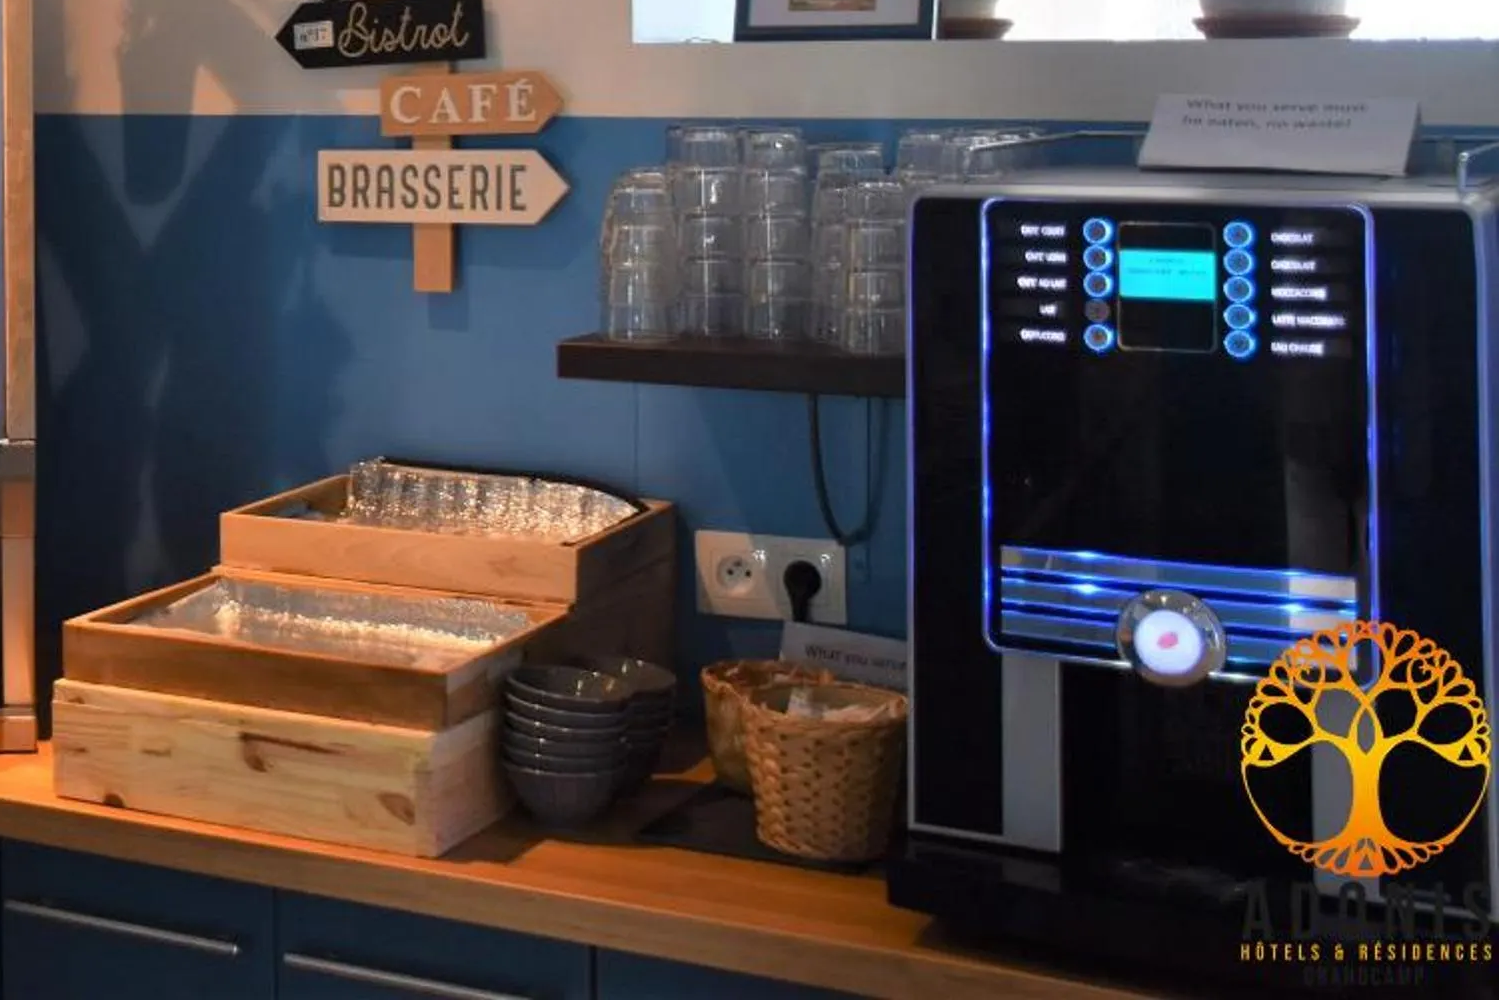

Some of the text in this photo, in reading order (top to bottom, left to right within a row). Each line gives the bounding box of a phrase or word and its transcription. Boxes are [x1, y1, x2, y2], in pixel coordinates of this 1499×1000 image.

[338, 1, 471, 58] Bistrot
[389, 78, 538, 124] CAFÉ
[327, 163, 527, 211] BRASSERIE
